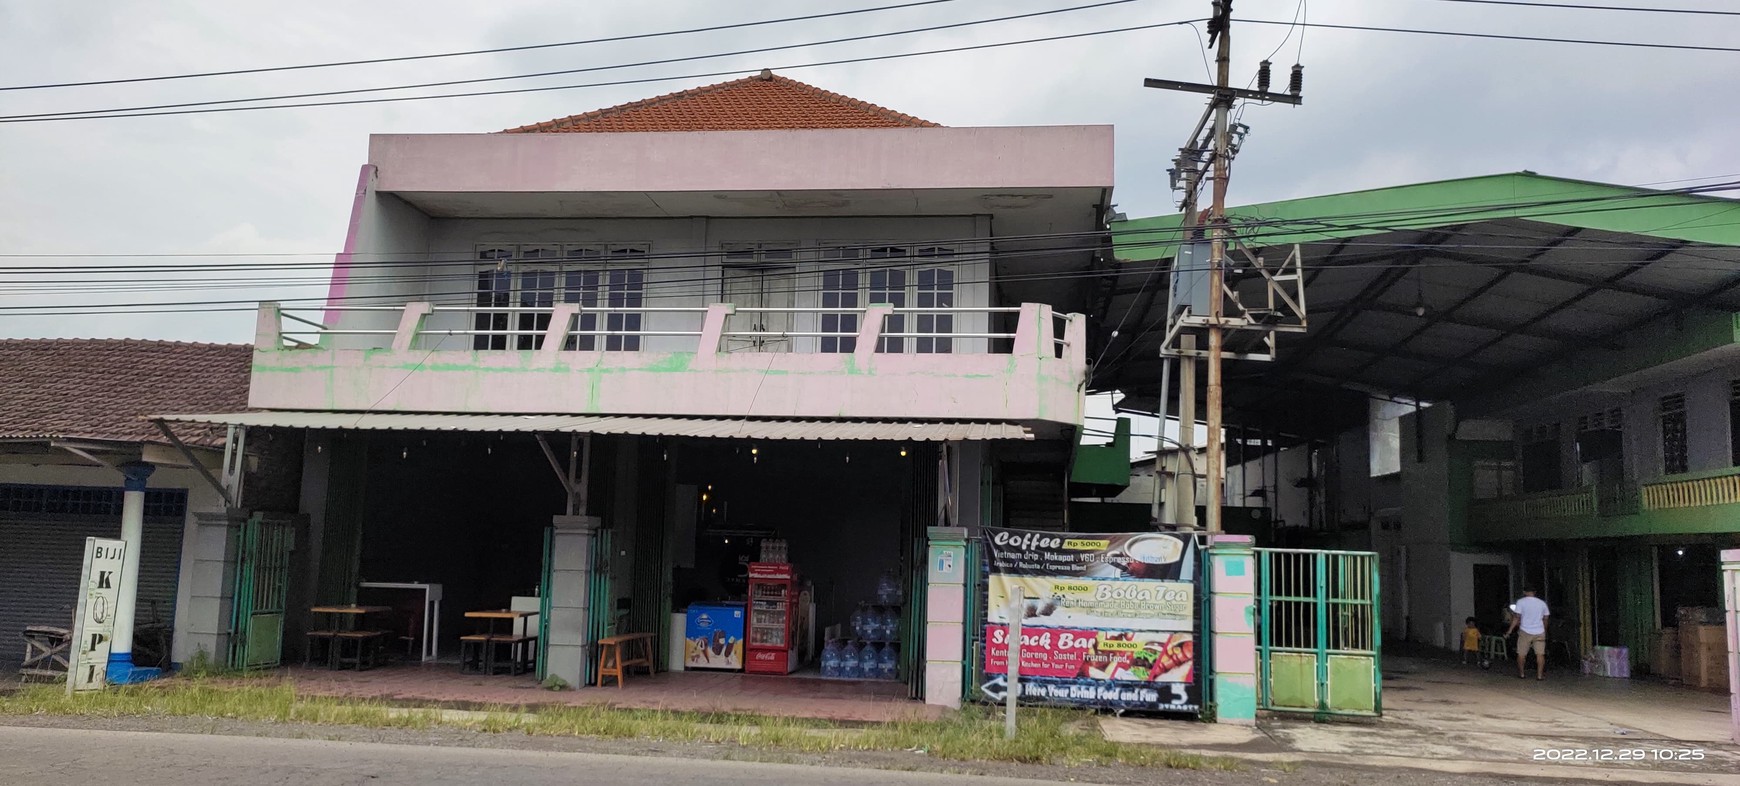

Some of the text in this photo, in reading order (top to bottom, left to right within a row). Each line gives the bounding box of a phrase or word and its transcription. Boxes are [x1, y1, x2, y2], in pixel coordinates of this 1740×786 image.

[994, 531, 1061, 550] Coffee
[1067, 541, 1078, 549] Rp
[95, 547, 122, 560] BIJI
[993, 549, 1022, 559] Vietnam
[1023, 551, 1038, 561] drip
[1054, 585, 1066, 593] Rp
[1095, 584, 1188, 602] Boba Tea
[87, 571, 113, 683] KOPI
[1058, 632, 1096, 649] Bar
[1021, 649, 1048, 660] Goreng
[1082, 651, 1108, 662] Frozen
[1025, 683, 1046, 696] Here
[1070, 685, 1096, 699] Drink
[1139, 688, 1158, 702] Fun
